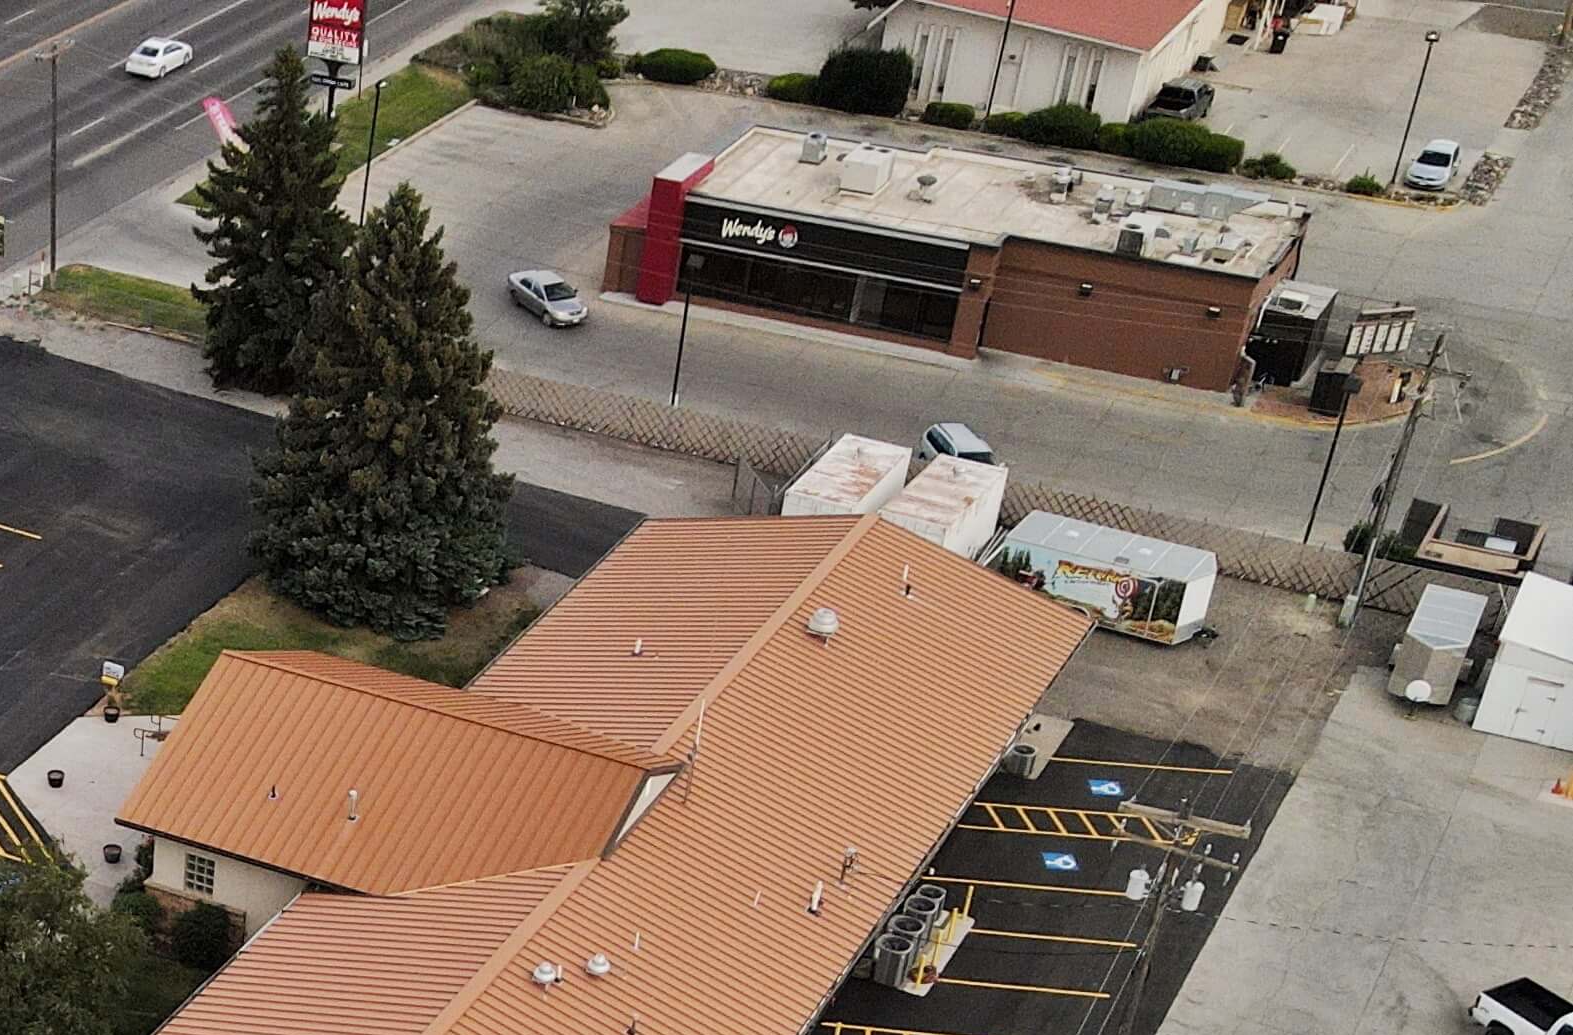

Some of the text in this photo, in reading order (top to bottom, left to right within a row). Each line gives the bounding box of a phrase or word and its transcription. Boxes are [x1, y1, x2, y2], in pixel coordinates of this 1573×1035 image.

[312, 0, 361, 26] Wendy's
[311, 26, 358, 42] QUALITY
[721, 218, 776, 245] Wendy's
